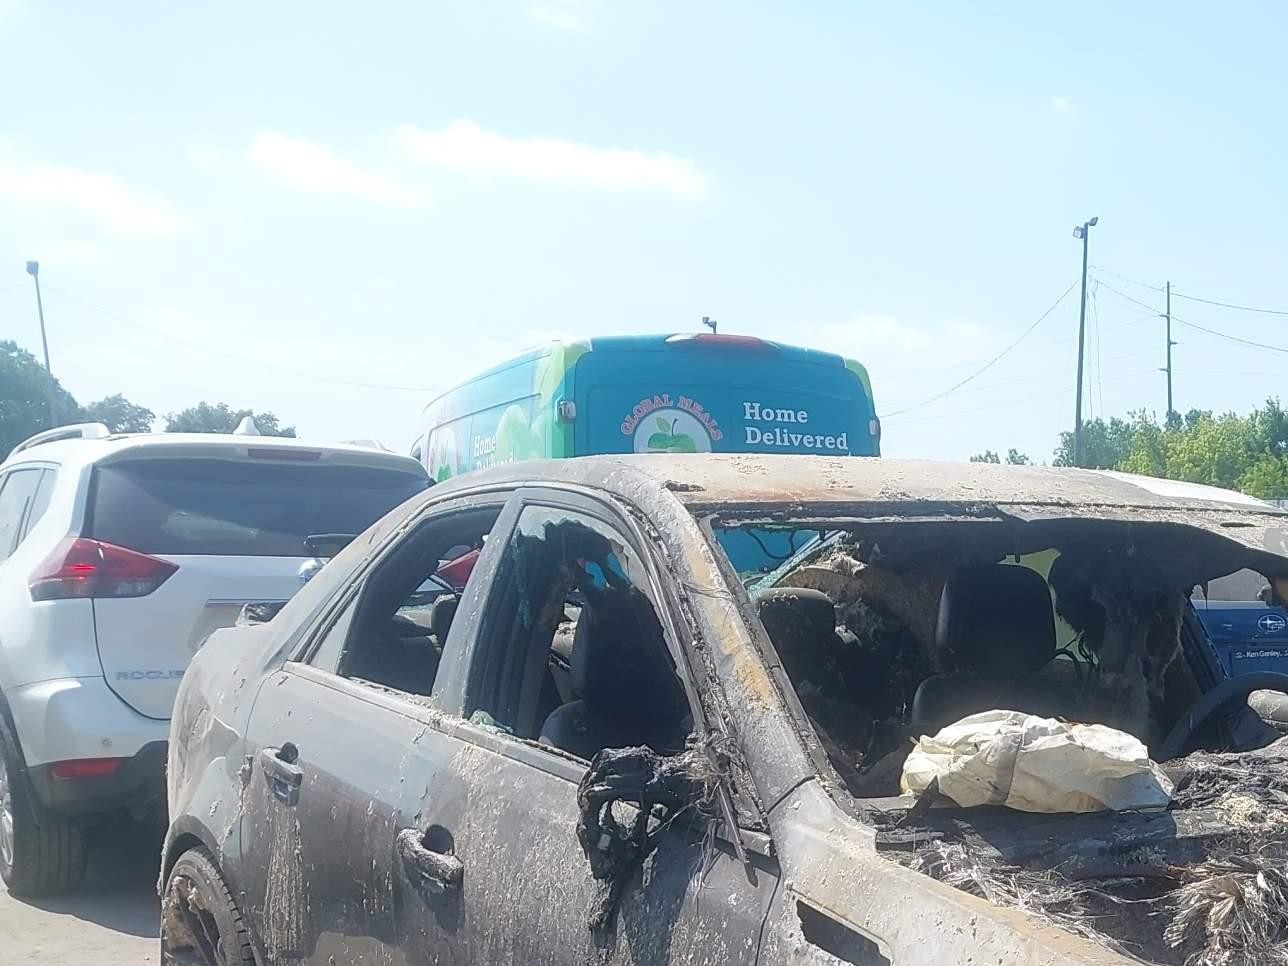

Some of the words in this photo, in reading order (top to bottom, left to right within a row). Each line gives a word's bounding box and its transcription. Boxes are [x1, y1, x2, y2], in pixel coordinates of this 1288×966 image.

[620, 394, 673, 435] GLOBAL
[677, 396, 724, 441] MEALS
[743, 402, 808, 423] Home
[474, 435, 496, 457] Home
[745, 427, 848, 450] Delivered
